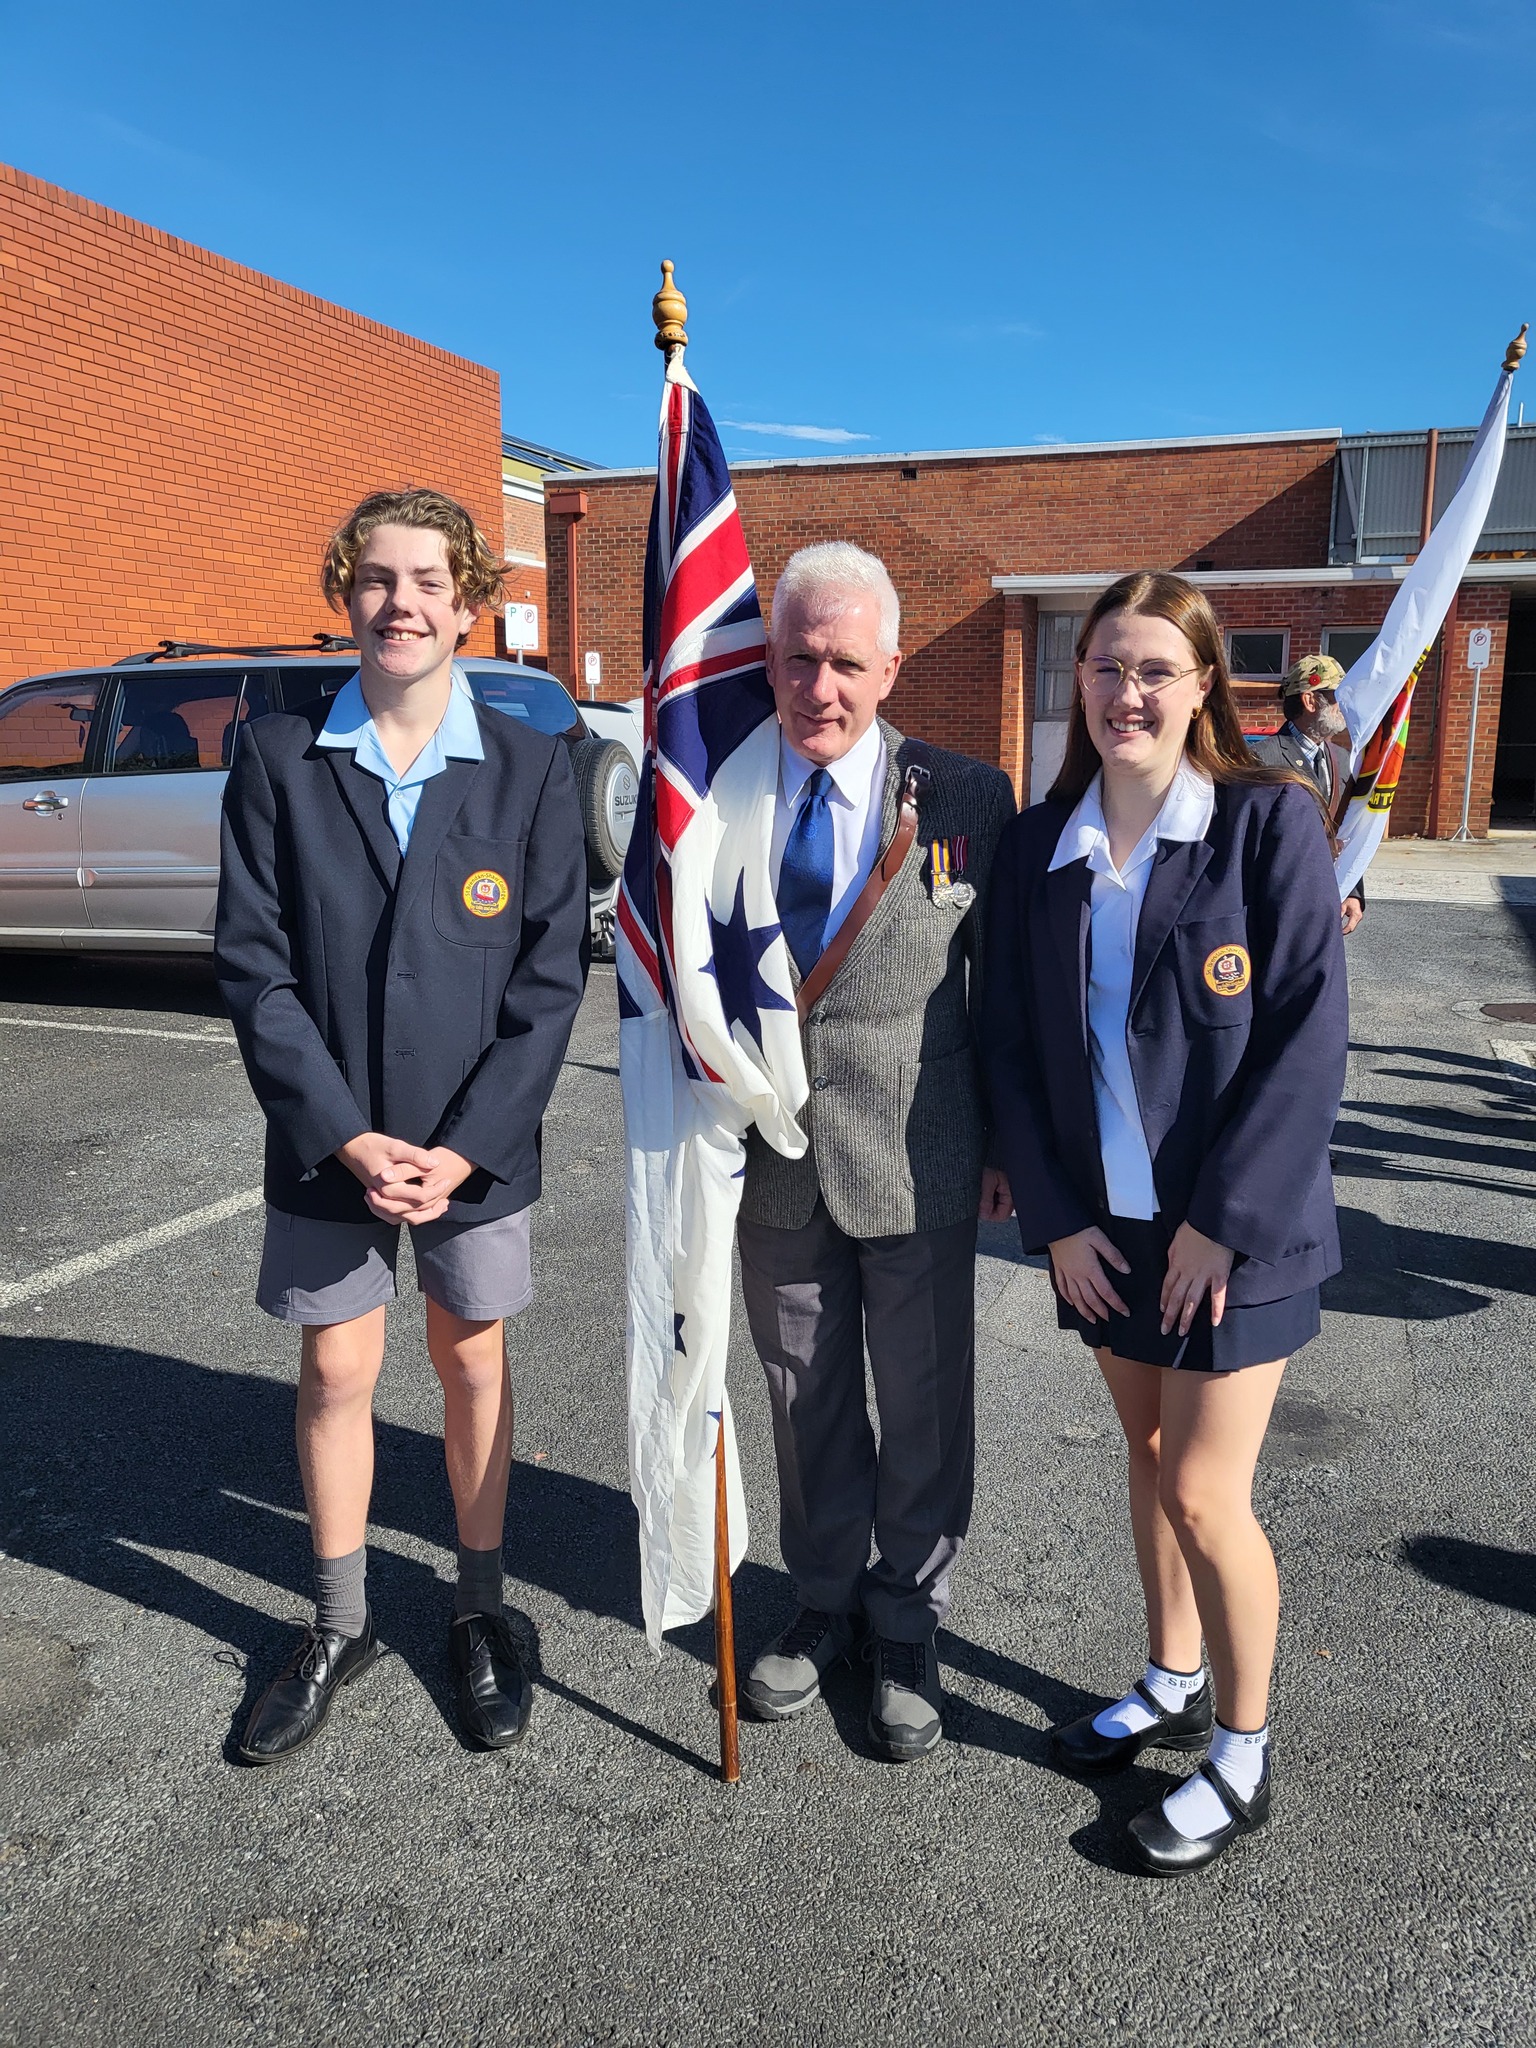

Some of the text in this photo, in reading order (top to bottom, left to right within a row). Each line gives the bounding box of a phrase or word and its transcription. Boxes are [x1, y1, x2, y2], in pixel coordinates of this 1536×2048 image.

[510, 606, 517, 617] P
[614, 794, 637, 807] SUZUK
[1244, 1732, 1266, 1745] SBS
